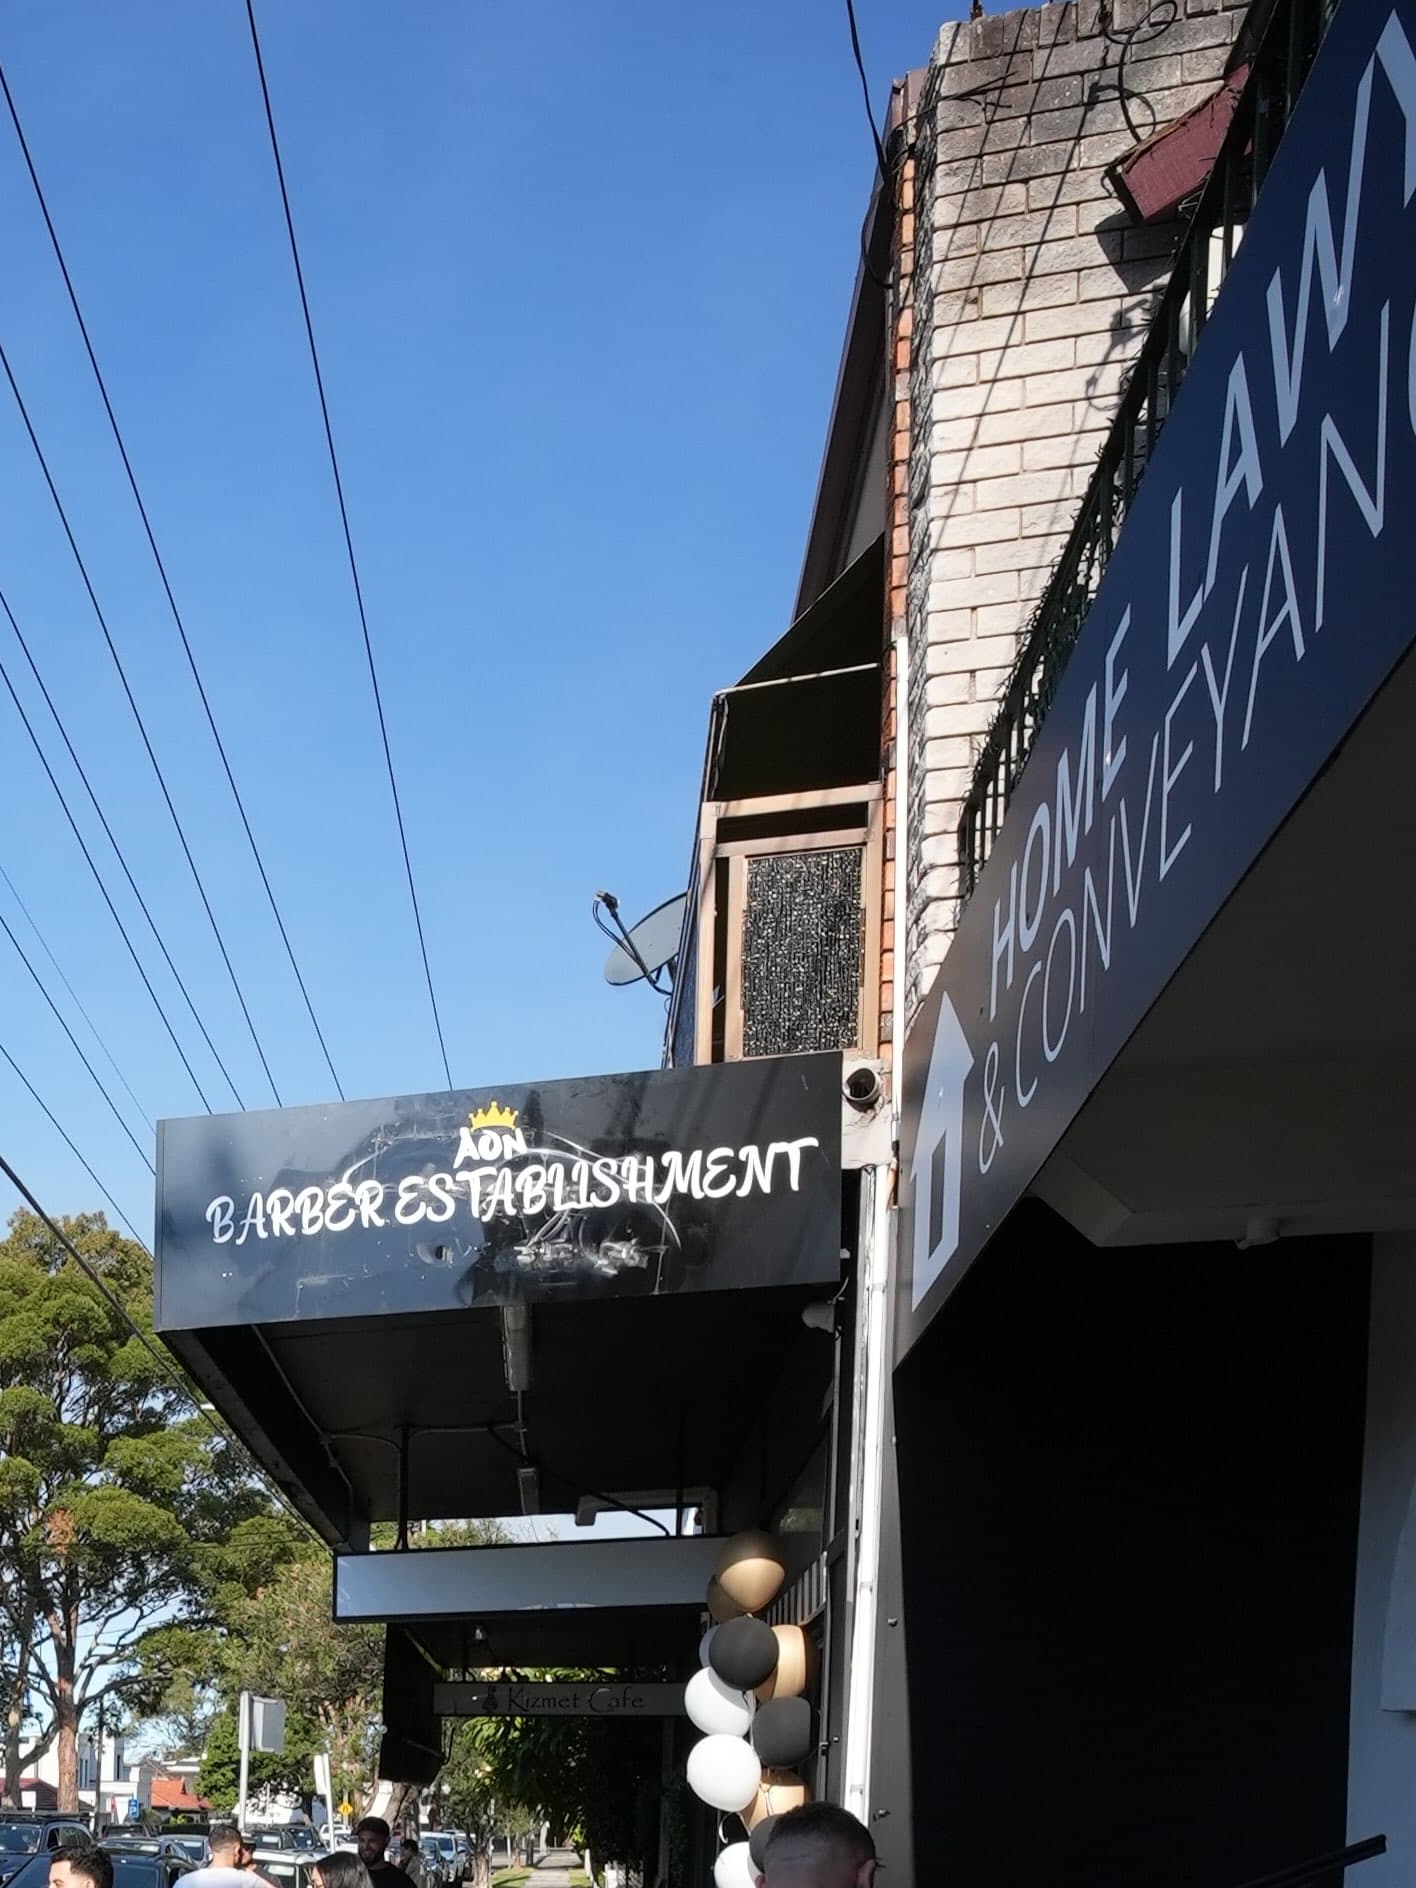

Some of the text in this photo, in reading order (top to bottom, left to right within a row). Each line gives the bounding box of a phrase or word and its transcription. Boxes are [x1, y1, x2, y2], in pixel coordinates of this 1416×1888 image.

[979, 299, 1416, 1175] & CONVEYAN
[990, 603, 1132, 1021] HOME
[205, 1137, 820, 1246] BARBER ESTABLISHMENT
[508, 1687, 645, 1713] Kizmet Cafe
